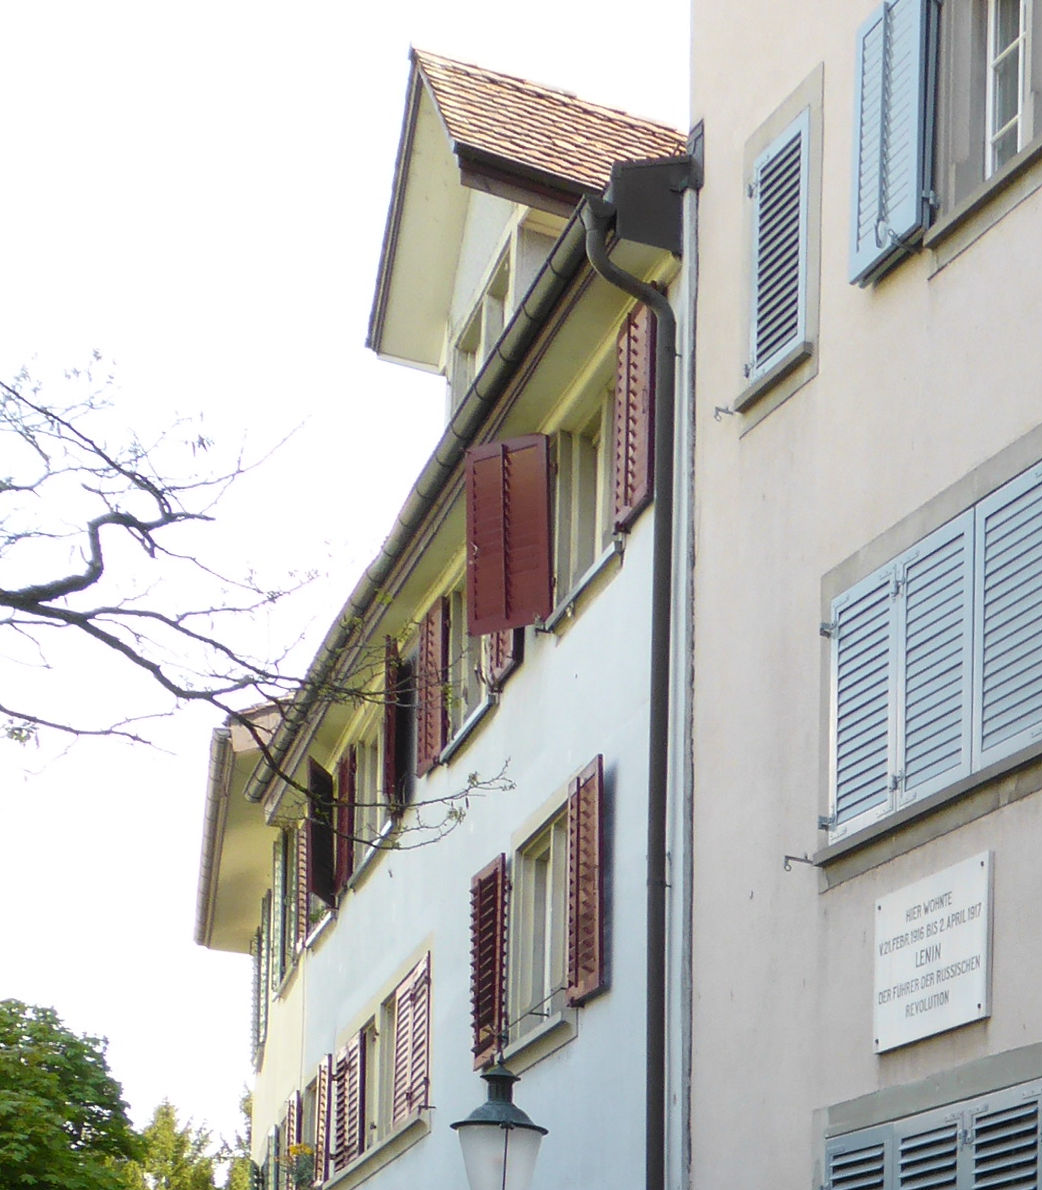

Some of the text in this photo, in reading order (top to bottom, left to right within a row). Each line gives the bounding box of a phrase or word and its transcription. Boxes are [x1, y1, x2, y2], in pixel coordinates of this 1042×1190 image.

[906, 891, 952, 923] HIER WOHNTE
[926, 921, 938, 938] BIS
[947, 909, 966, 929] APRIL
[967, 902, 982, 920] 1917
[915, 943, 942, 968] LENIN
[878, 988, 892, 1005] DER
[920, 972, 935, 990] DER
[936, 955, 981, 984] RUSSISCHEN
[905, 990, 950, 1018] REVOLUTION
